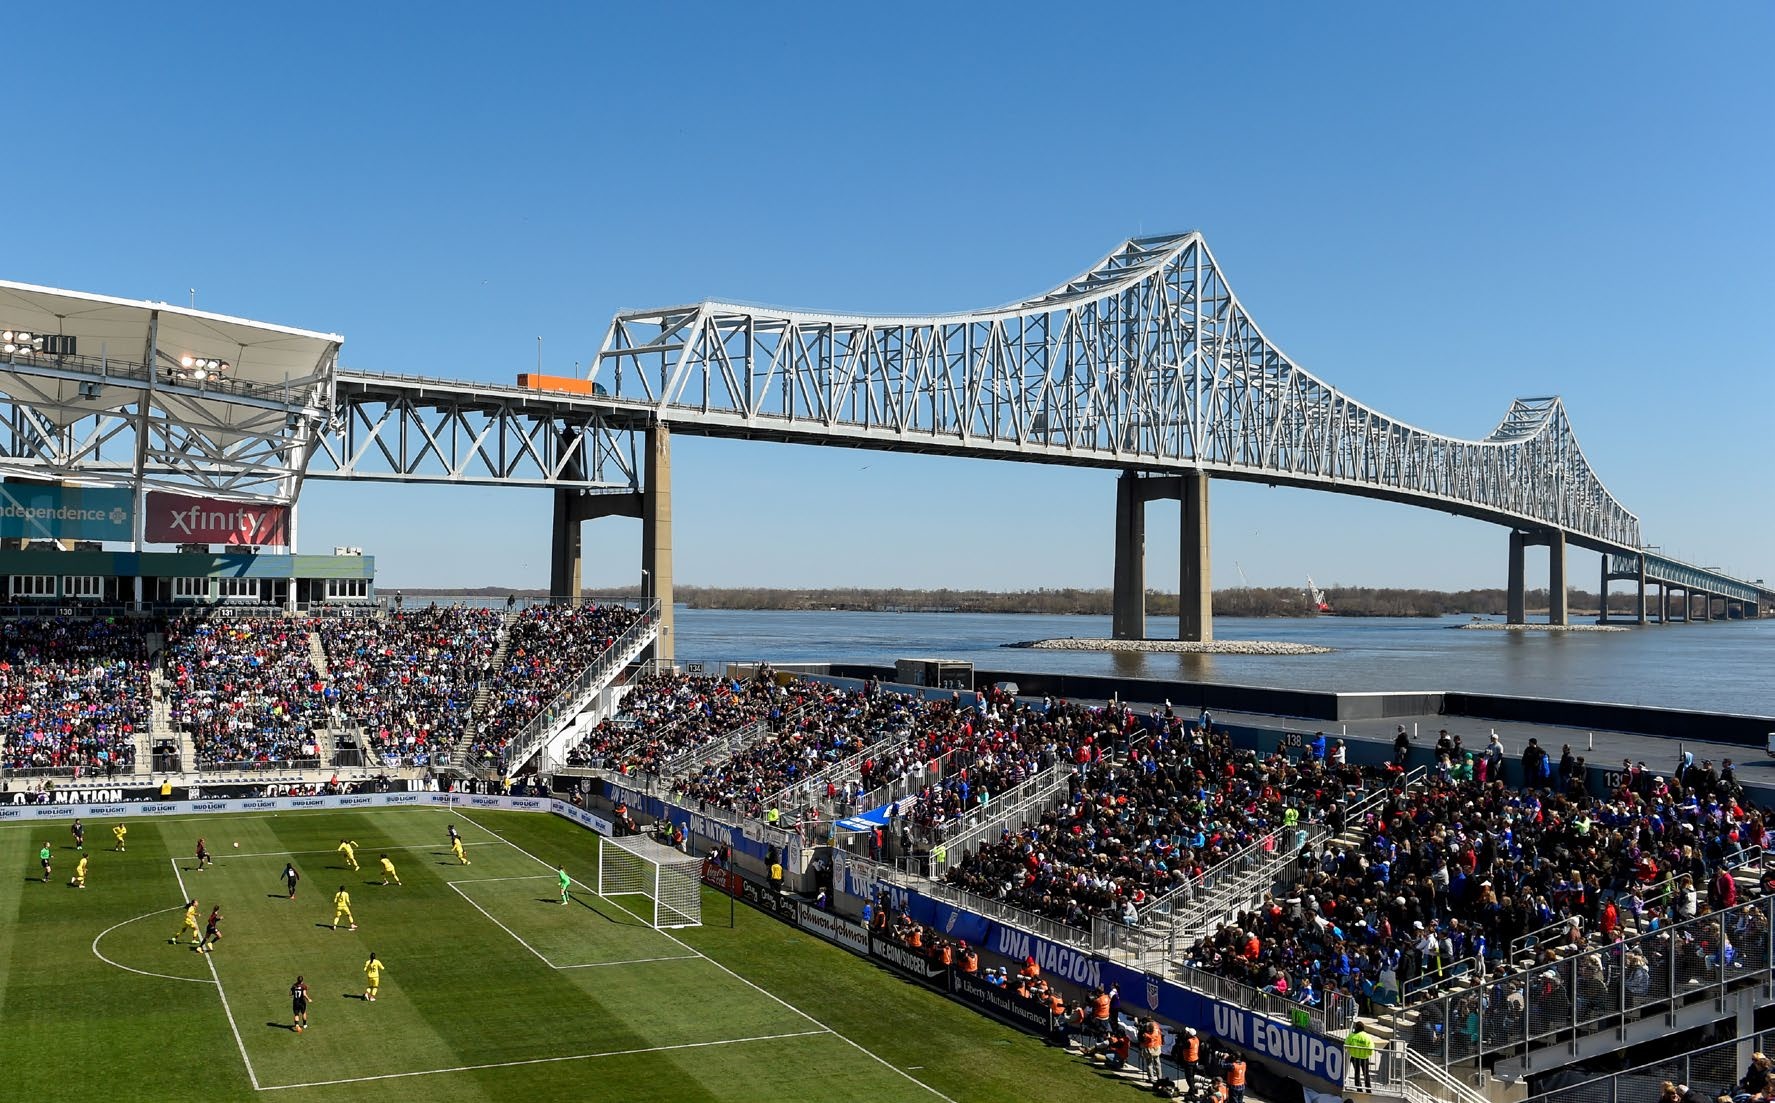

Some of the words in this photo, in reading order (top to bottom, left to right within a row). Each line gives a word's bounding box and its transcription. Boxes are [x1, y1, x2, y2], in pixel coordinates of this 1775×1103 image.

[170, 505, 266, 536] xfinity
[60, 608, 73, 616] 130
[221, 609, 233, 617] 131
[689, 664, 701, 672] 134
[1287, 734, 1302, 747] 138
[55, 790, 122, 805] NATION
[1000, 926, 1030, 961] UNA
[1035, 940, 1101, 988] NACION
[295, 990, 302, 998] 17
[963, 980, 986, 1002] Liberty
[986, 990, 1010, 1010] Mutual
[1011, 1001, 1047, 1026] Insurance
[1213, 1003, 1245, 1044] UN
[1253, 1016, 1343, 1081] EQUIPO
